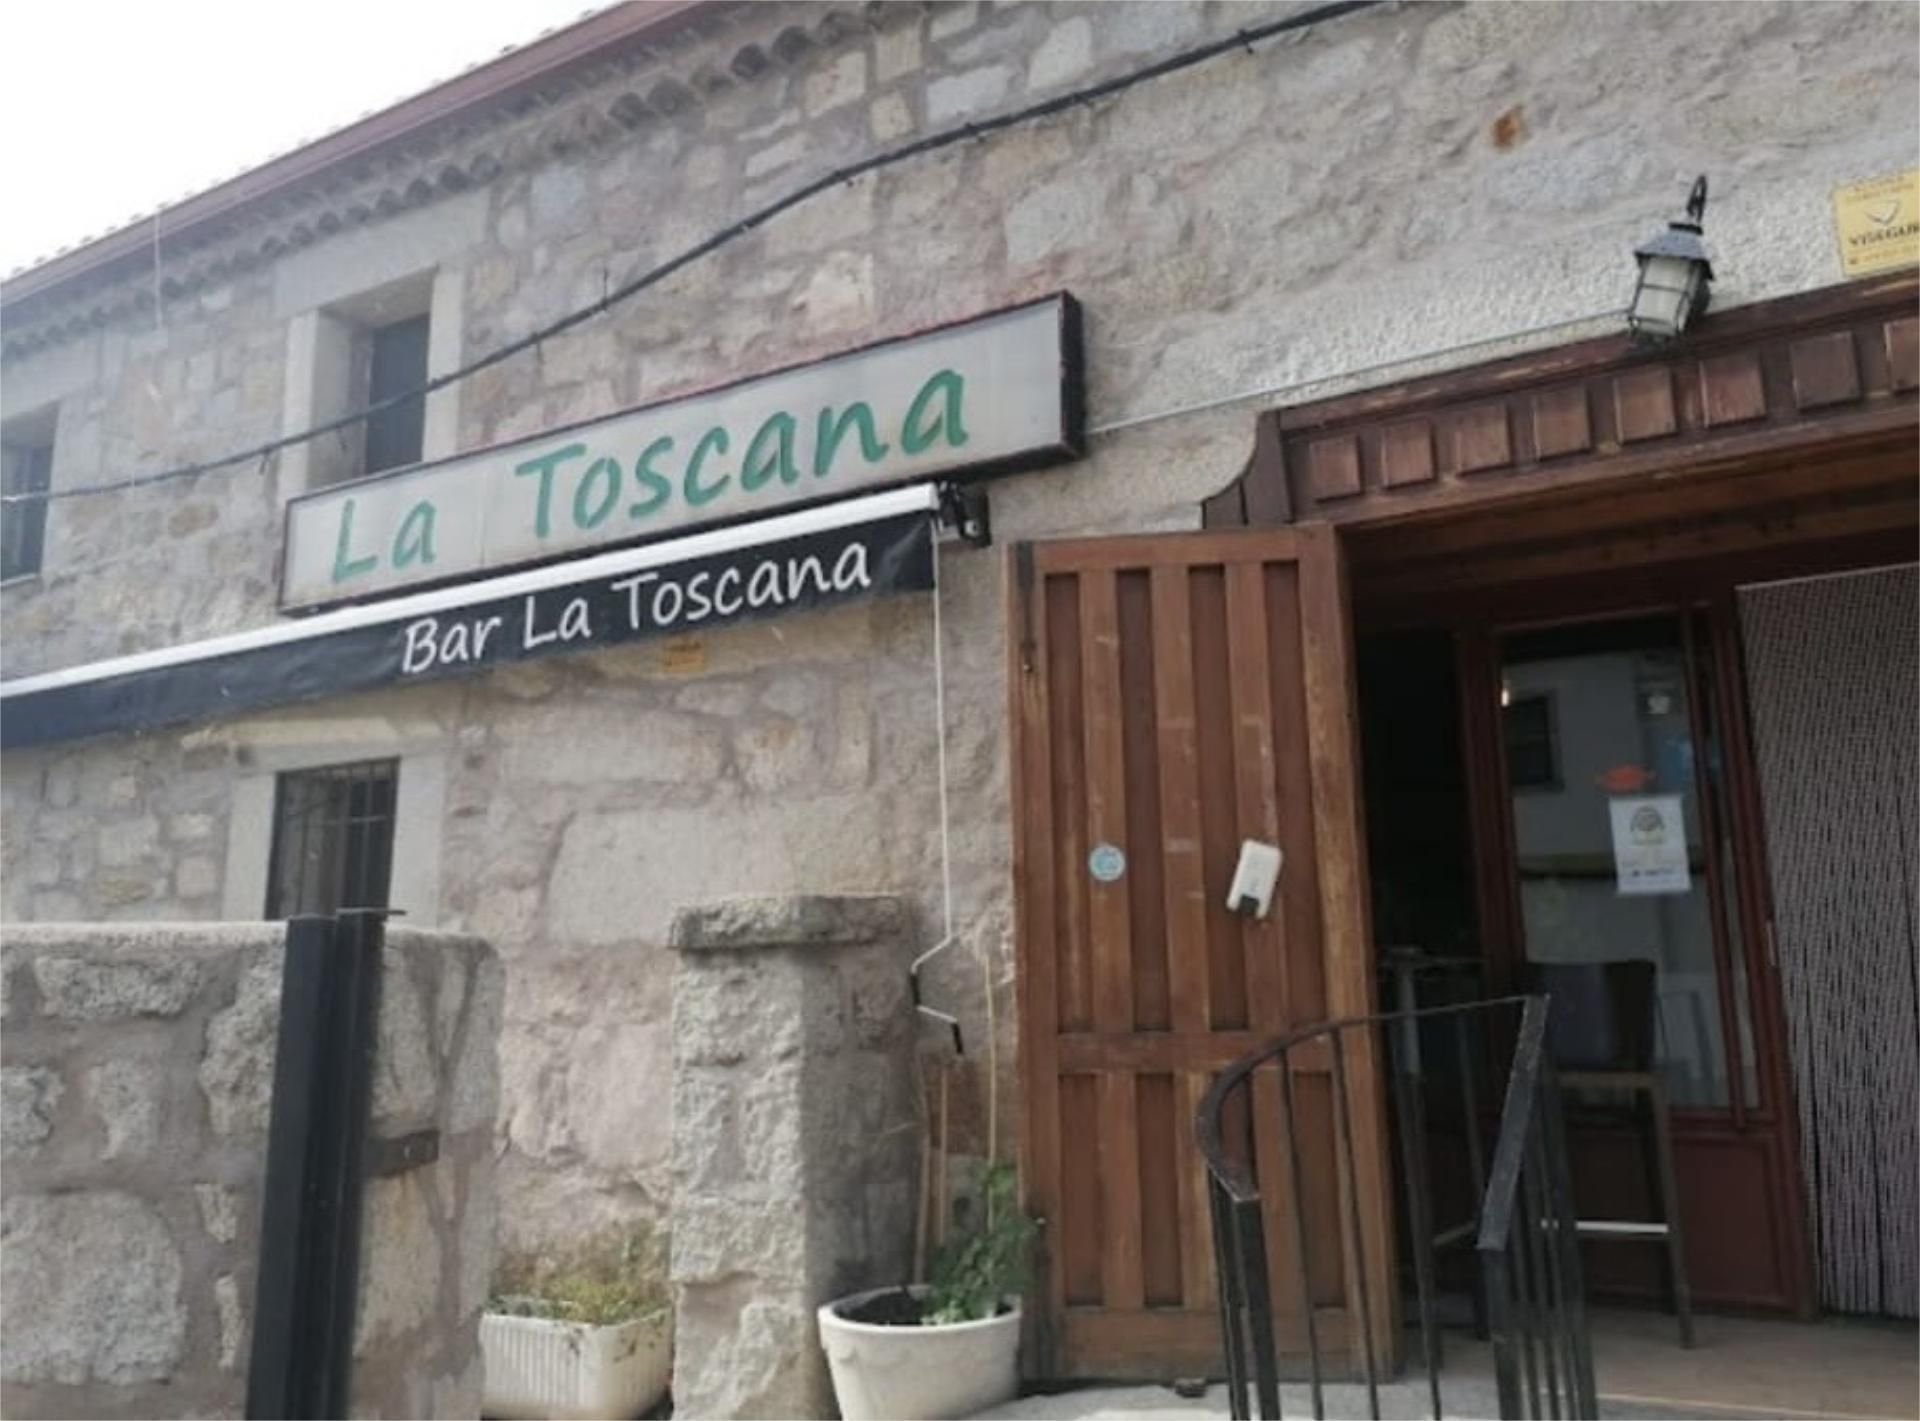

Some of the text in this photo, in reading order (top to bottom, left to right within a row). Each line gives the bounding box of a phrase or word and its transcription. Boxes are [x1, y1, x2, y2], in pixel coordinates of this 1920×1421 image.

[331, 369, 968, 583] La Toscana
[402, 541, 872, 674] Bar La Toscana
